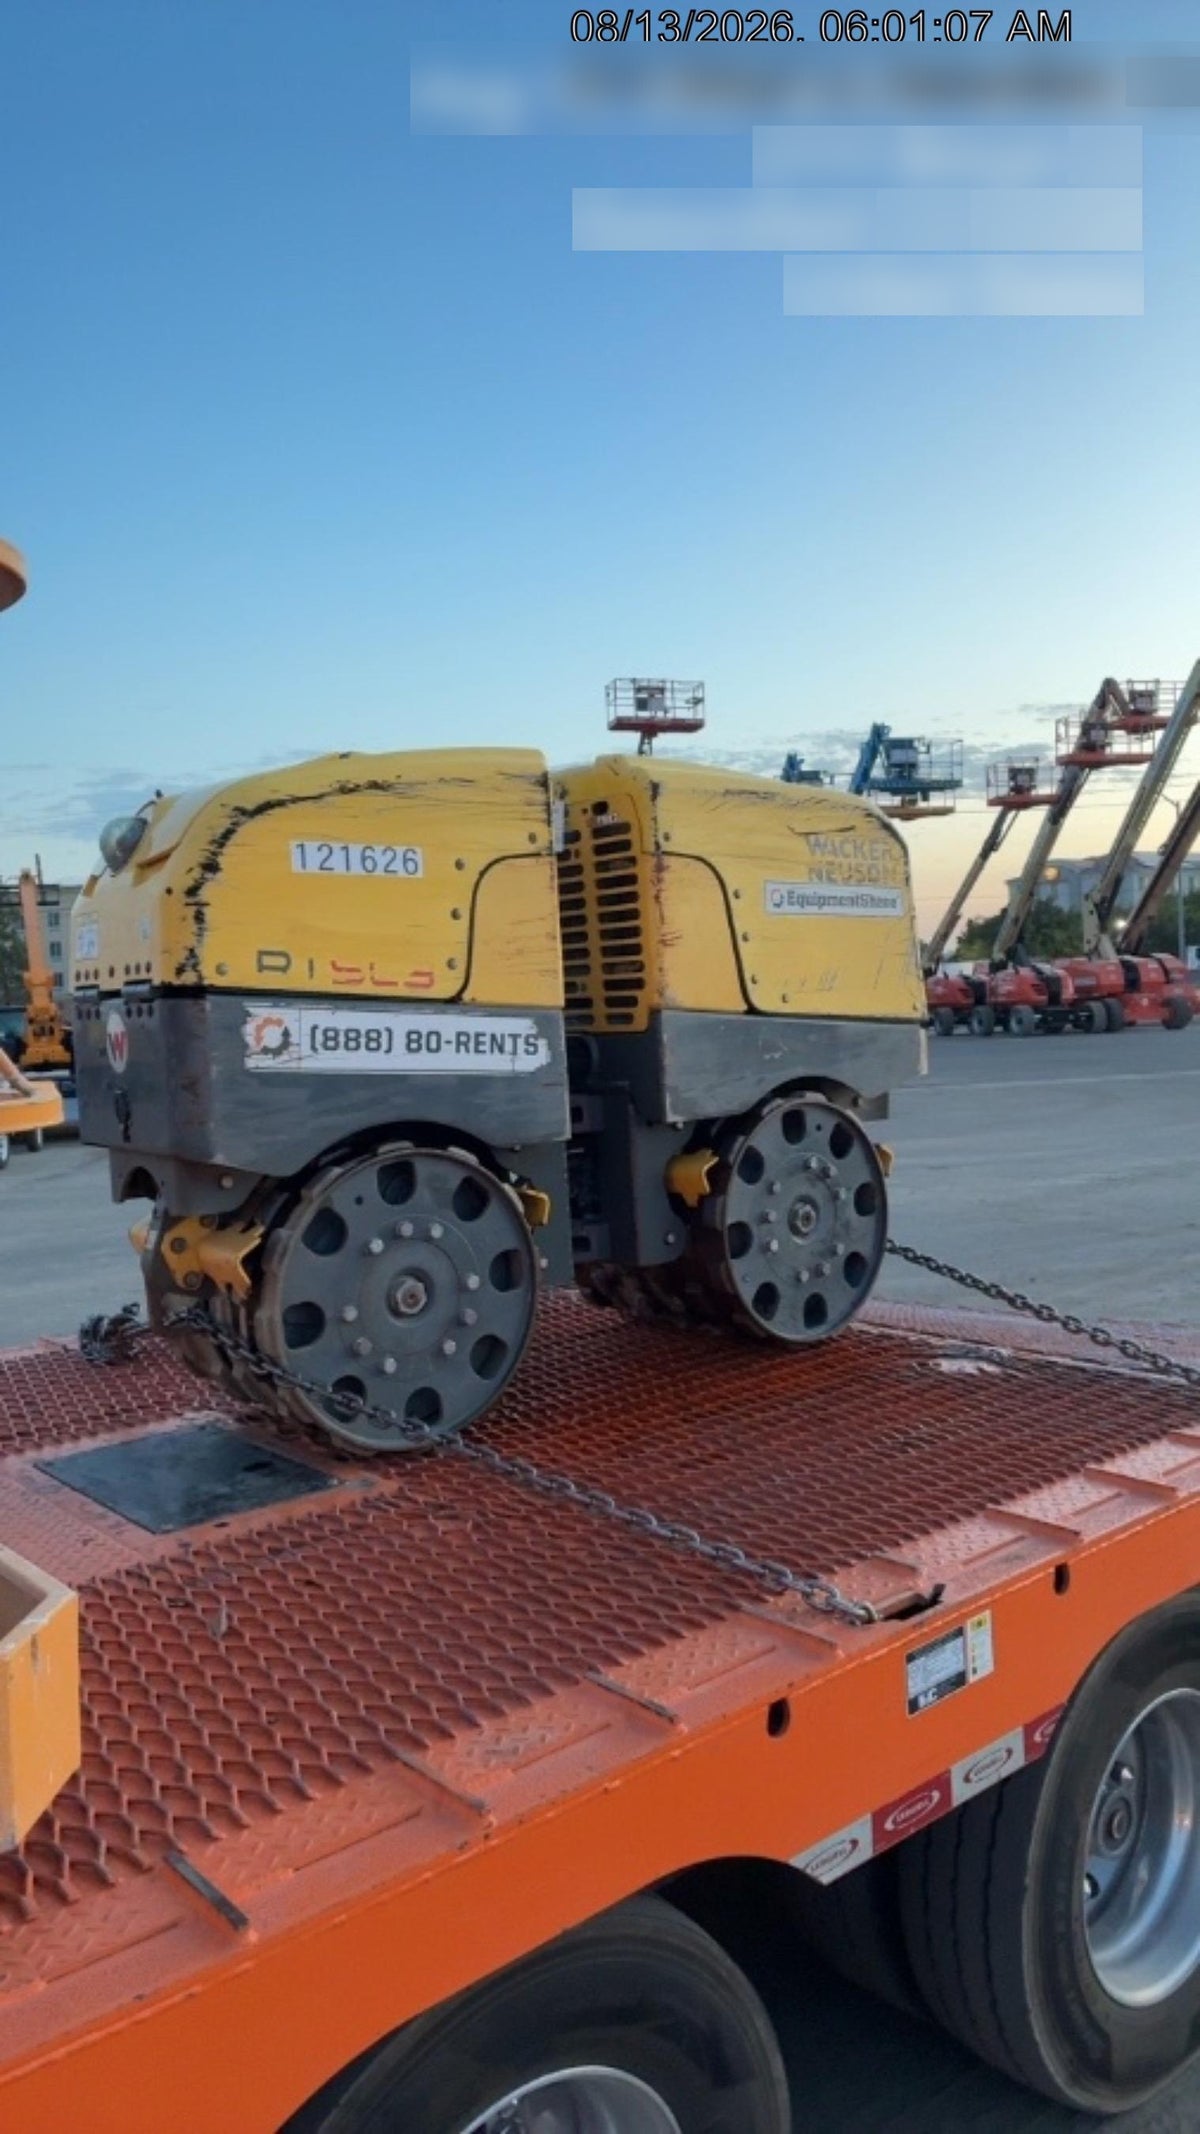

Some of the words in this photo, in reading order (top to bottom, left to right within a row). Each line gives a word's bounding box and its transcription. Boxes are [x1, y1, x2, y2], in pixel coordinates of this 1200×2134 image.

[296, 843, 419, 875] 121626
[310, 1024, 393, 1054] (888)
[405, 1030, 539, 1056] 80-RENTS
